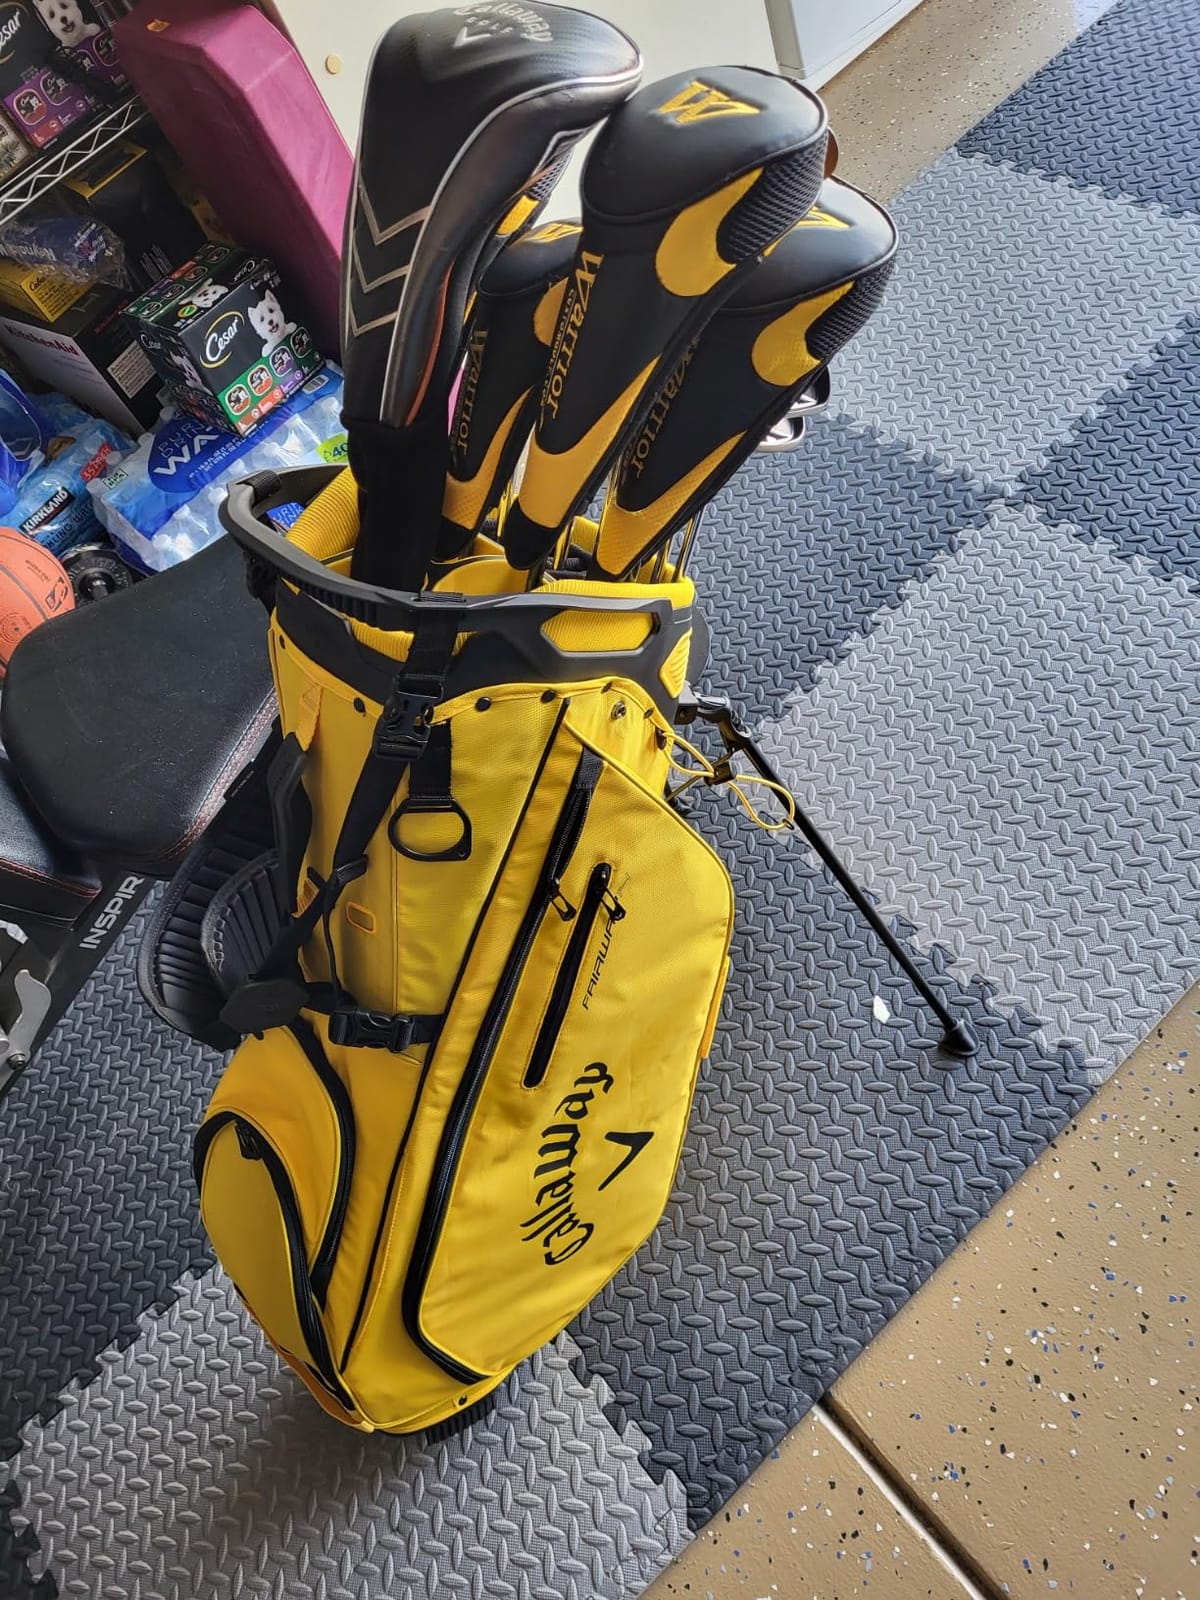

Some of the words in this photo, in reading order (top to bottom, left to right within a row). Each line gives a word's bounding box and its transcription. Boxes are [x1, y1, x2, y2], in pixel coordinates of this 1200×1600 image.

[454, 3, 553, 41] Callaway
[205, 316, 240, 362] Cesar
[547, 251, 604, 419] Warrior
[458, 330, 488, 456] Warrior
[153, 426, 219, 475] WA
[23, 489, 69, 532] KIRKLAND
[79, 873, 145, 950] INSPIR
[582, 900, 617, 1010] FAIRWA
[520, 1062, 614, 1266] Callaway
